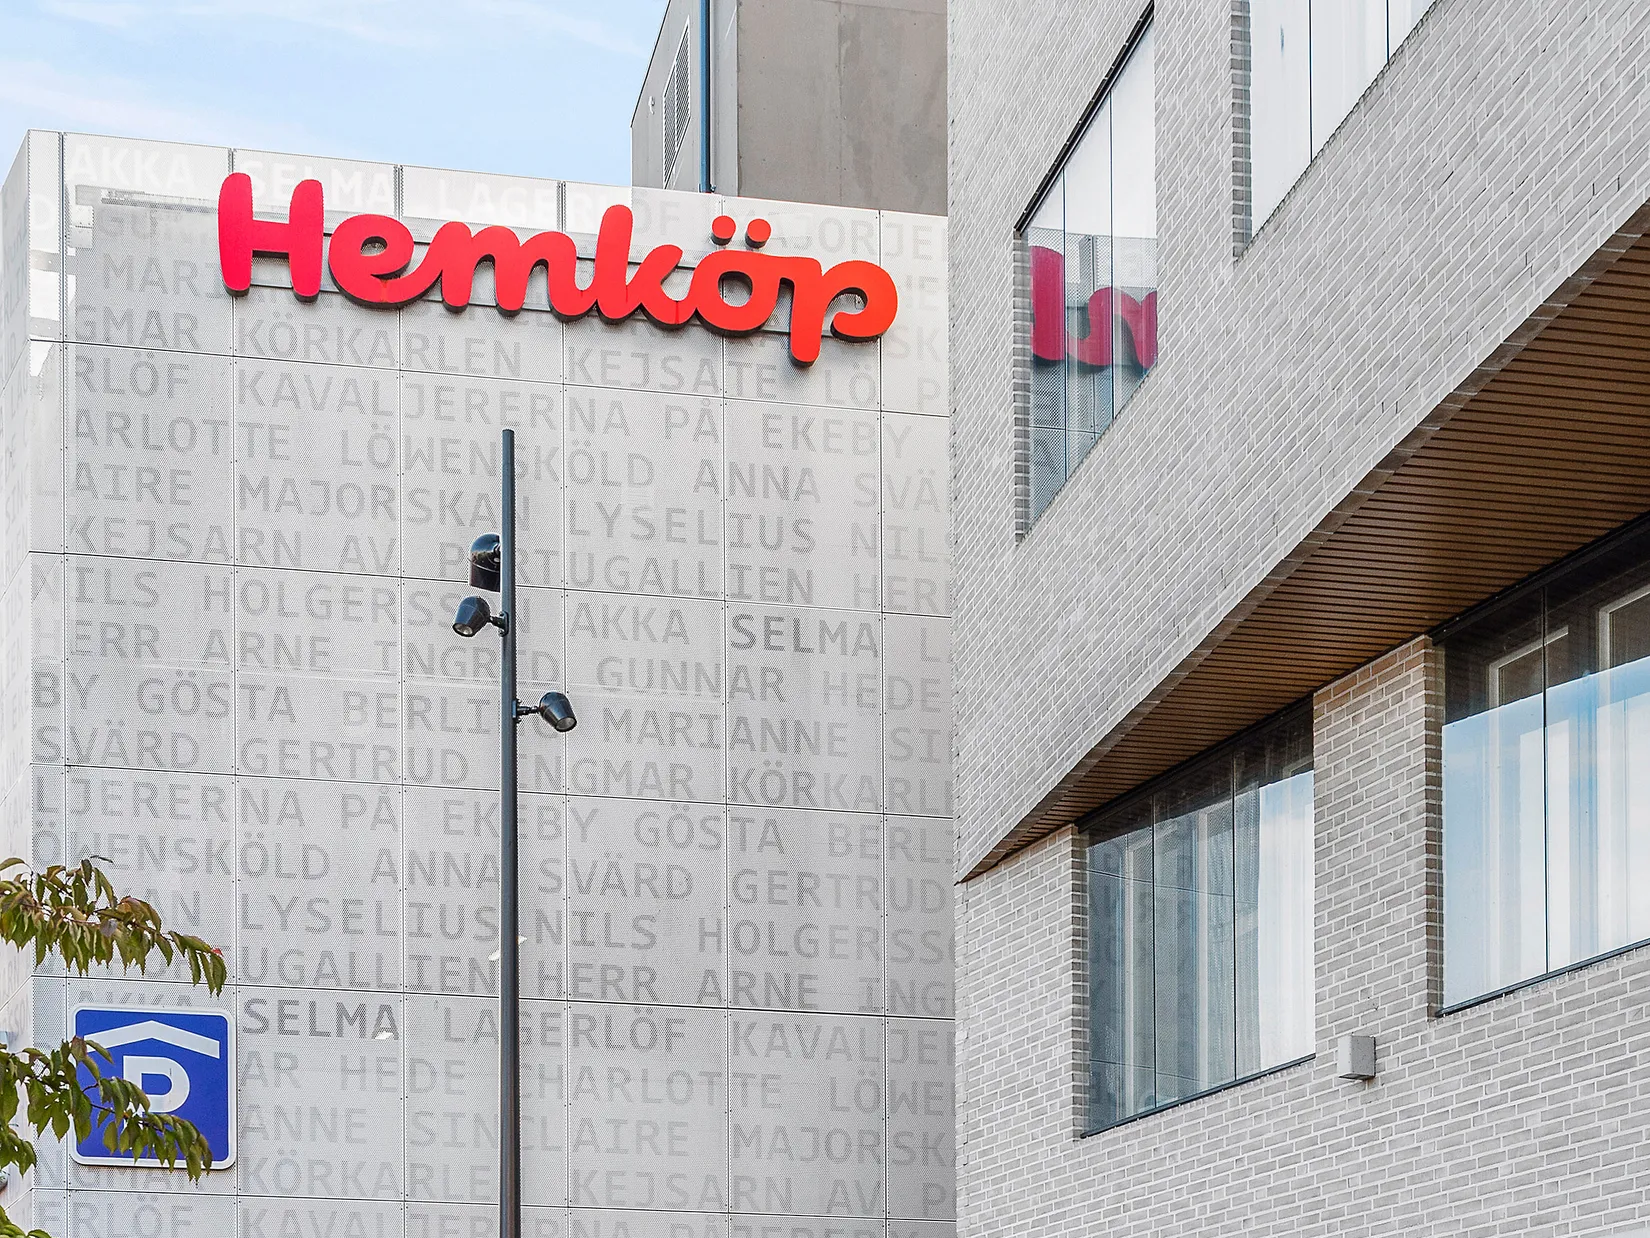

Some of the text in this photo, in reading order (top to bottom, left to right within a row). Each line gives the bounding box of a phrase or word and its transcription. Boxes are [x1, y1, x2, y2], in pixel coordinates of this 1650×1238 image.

[218, 172, 898, 367] Hemköp
[238, 312, 521, 377] KÖRKARLEN
[238, 368, 631, 436] KAVALJERERNA
[665, 400, 720, 444] PÅ
[762, 413, 912, 459] EKEBY
[342, 422, 655, 488] LÖWENSKÖLD
[693, 458, 820, 503] ANNA
[67, 513, 951, 614] KEJSARN AV PRTUGALLIEN HER
[569, 500, 815, 556] LYSELIUS
[203, 574, 531, 635] HOLGERS
[570, 602, 690, 645] AKKA
[730, 614, 879, 659] SELMA
[201, 628, 332, 674] ARNE
[373, 638, 560, 684] INGRD
[595, 655, 785, 703] GUNNAR
[823, 670, 942, 714] HEDE
[136, 669, 297, 724] GÖSTA
[603, 706, 848, 758] MARIANNE
[35, 718, 200, 769] SVÄRD
[240, 737, 469, 785] GERTRUD
[729, 760, 952, 815] KÖRKARL
[341, 786, 398, 831] PÅ
[634, 803, 785, 855] GÖSTA
[370, 848, 500, 889] ANNA
[538, 852, 693, 900] SVÄRD
[732, 869, 945, 914] GERTRUD
[242, 892, 498, 942] LYSELIUS
[535, 909, 657, 951] NILS
[699, 917, 955, 966] HOLGERSS
[242, 998, 400, 1041] SELMA
[538, 960, 660, 1002] HERR
[698, 969, 818, 1011] ARNE
[858, 977, 955, 1018] ING
[341, 1055, 466, 1096] HEDE
[829, 1069, 955, 1116] LÖWE
[242, 1148, 500, 1201] KÖRKARLE
[573, 1168, 792, 1214] KEJSARN
[826, 1179, 882, 1214] AV
[732, 1123, 955, 1169] MAJORSK
